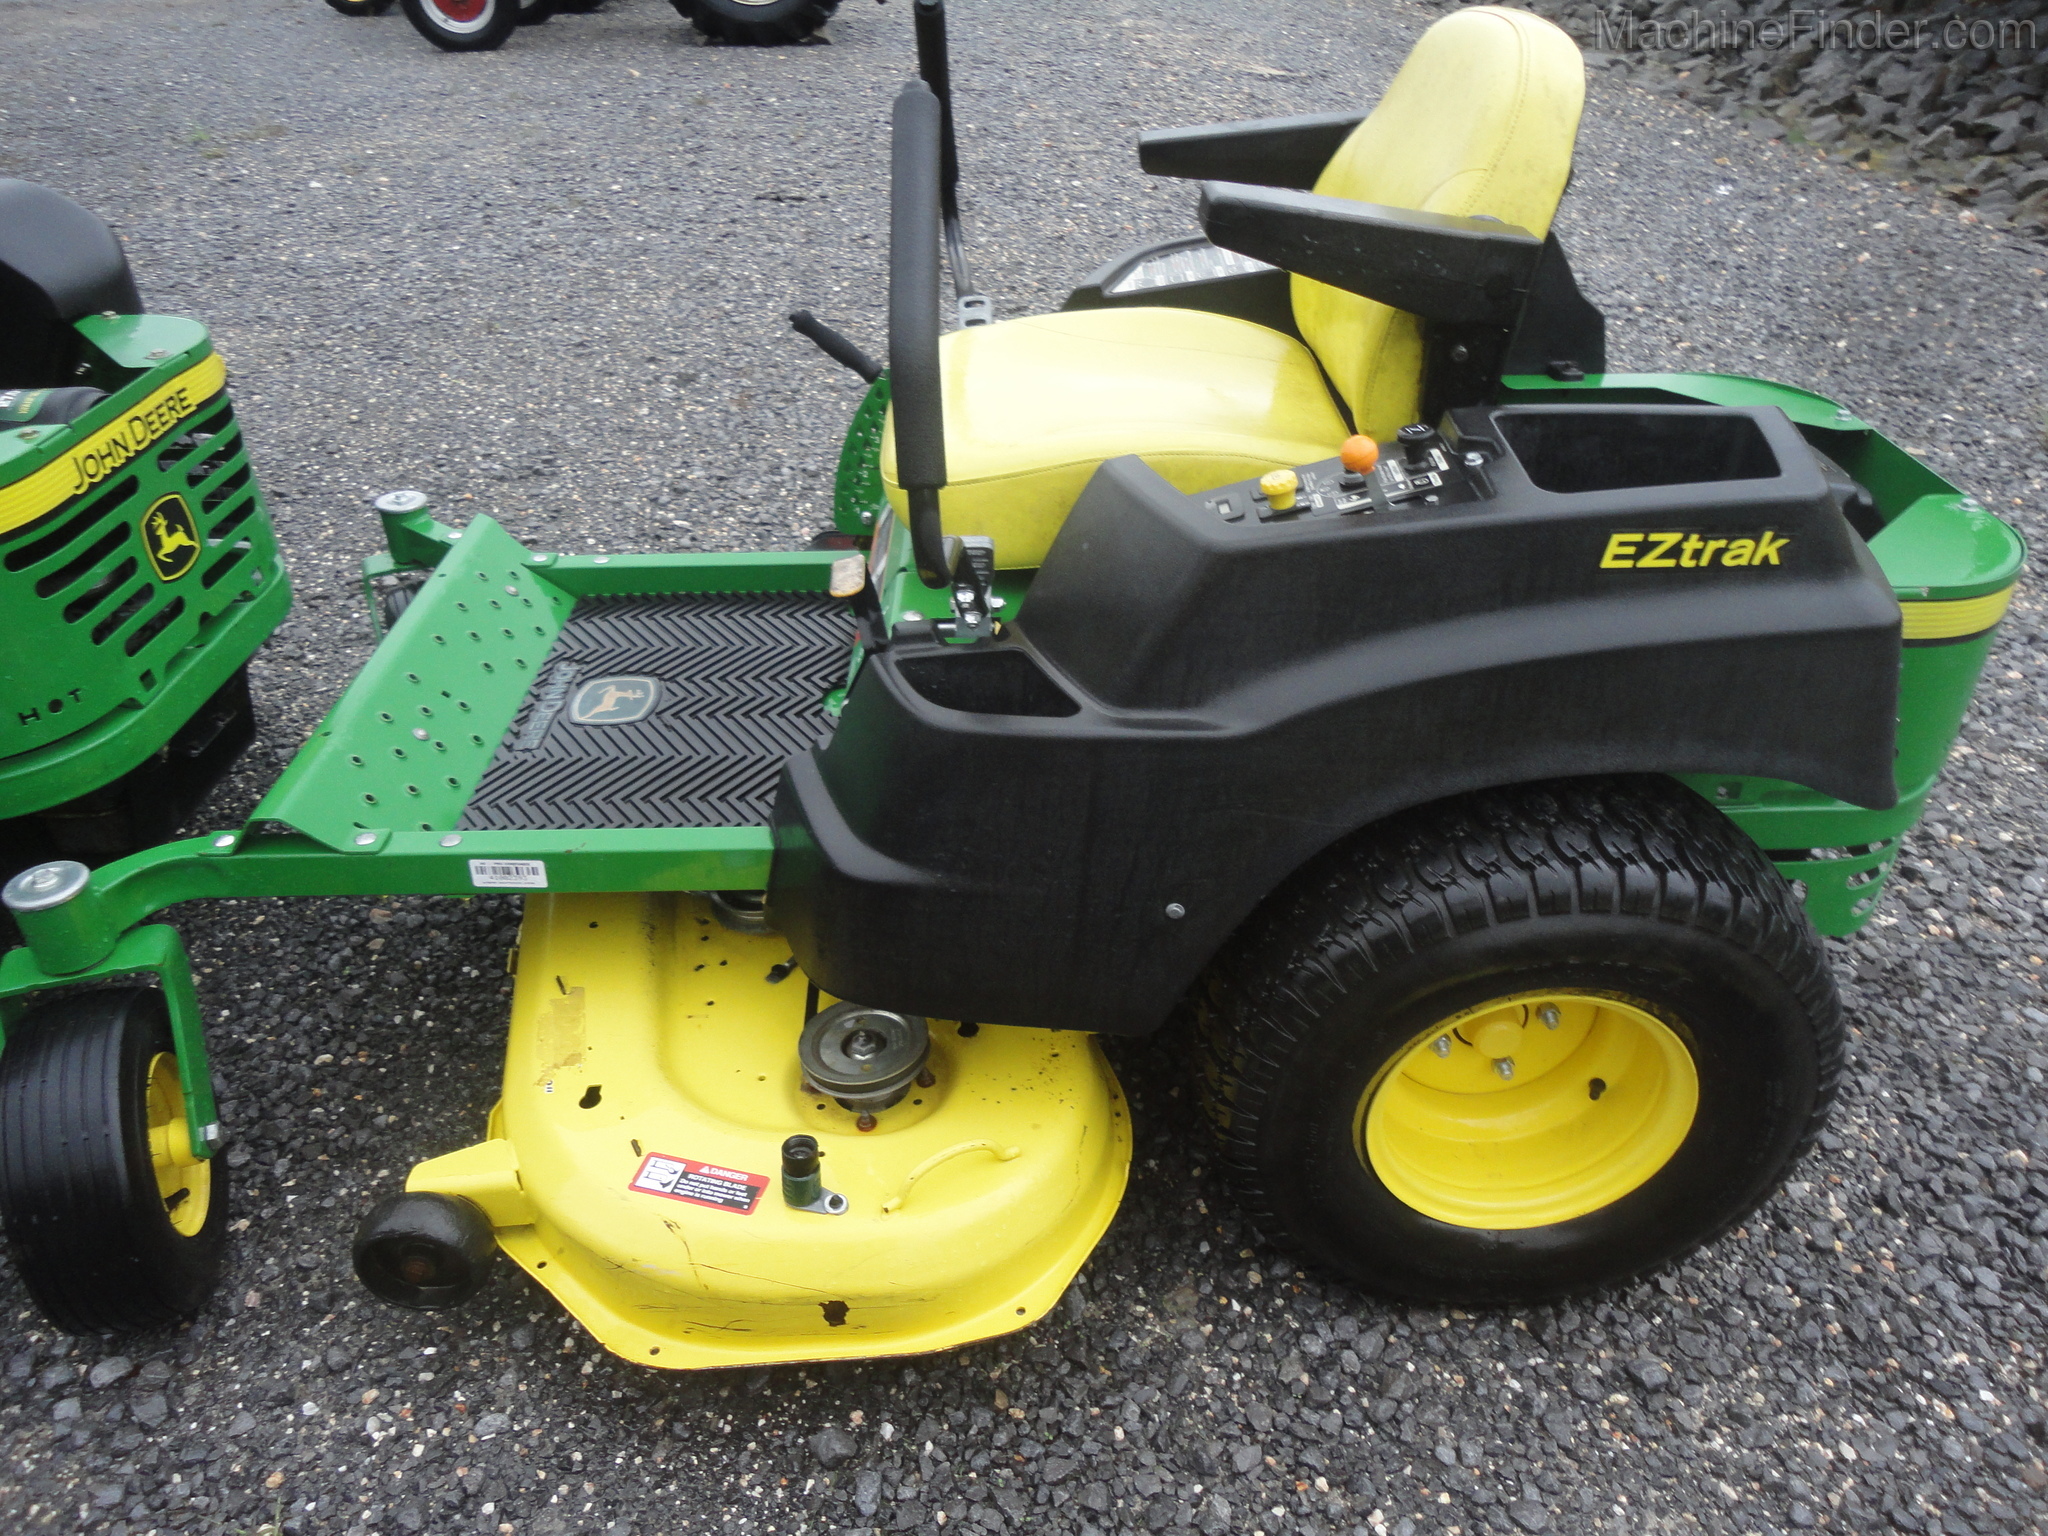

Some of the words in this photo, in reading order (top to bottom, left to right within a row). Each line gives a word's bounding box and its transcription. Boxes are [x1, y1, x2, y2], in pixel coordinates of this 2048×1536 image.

[72, 431, 133, 492] JOHN
[128, 387, 195, 448] DEERE
[1599, 531, 1790, 568] EZtrak
[545, 663, 583, 700] JOHN
[709, 1167, 749, 1181] DANGER
